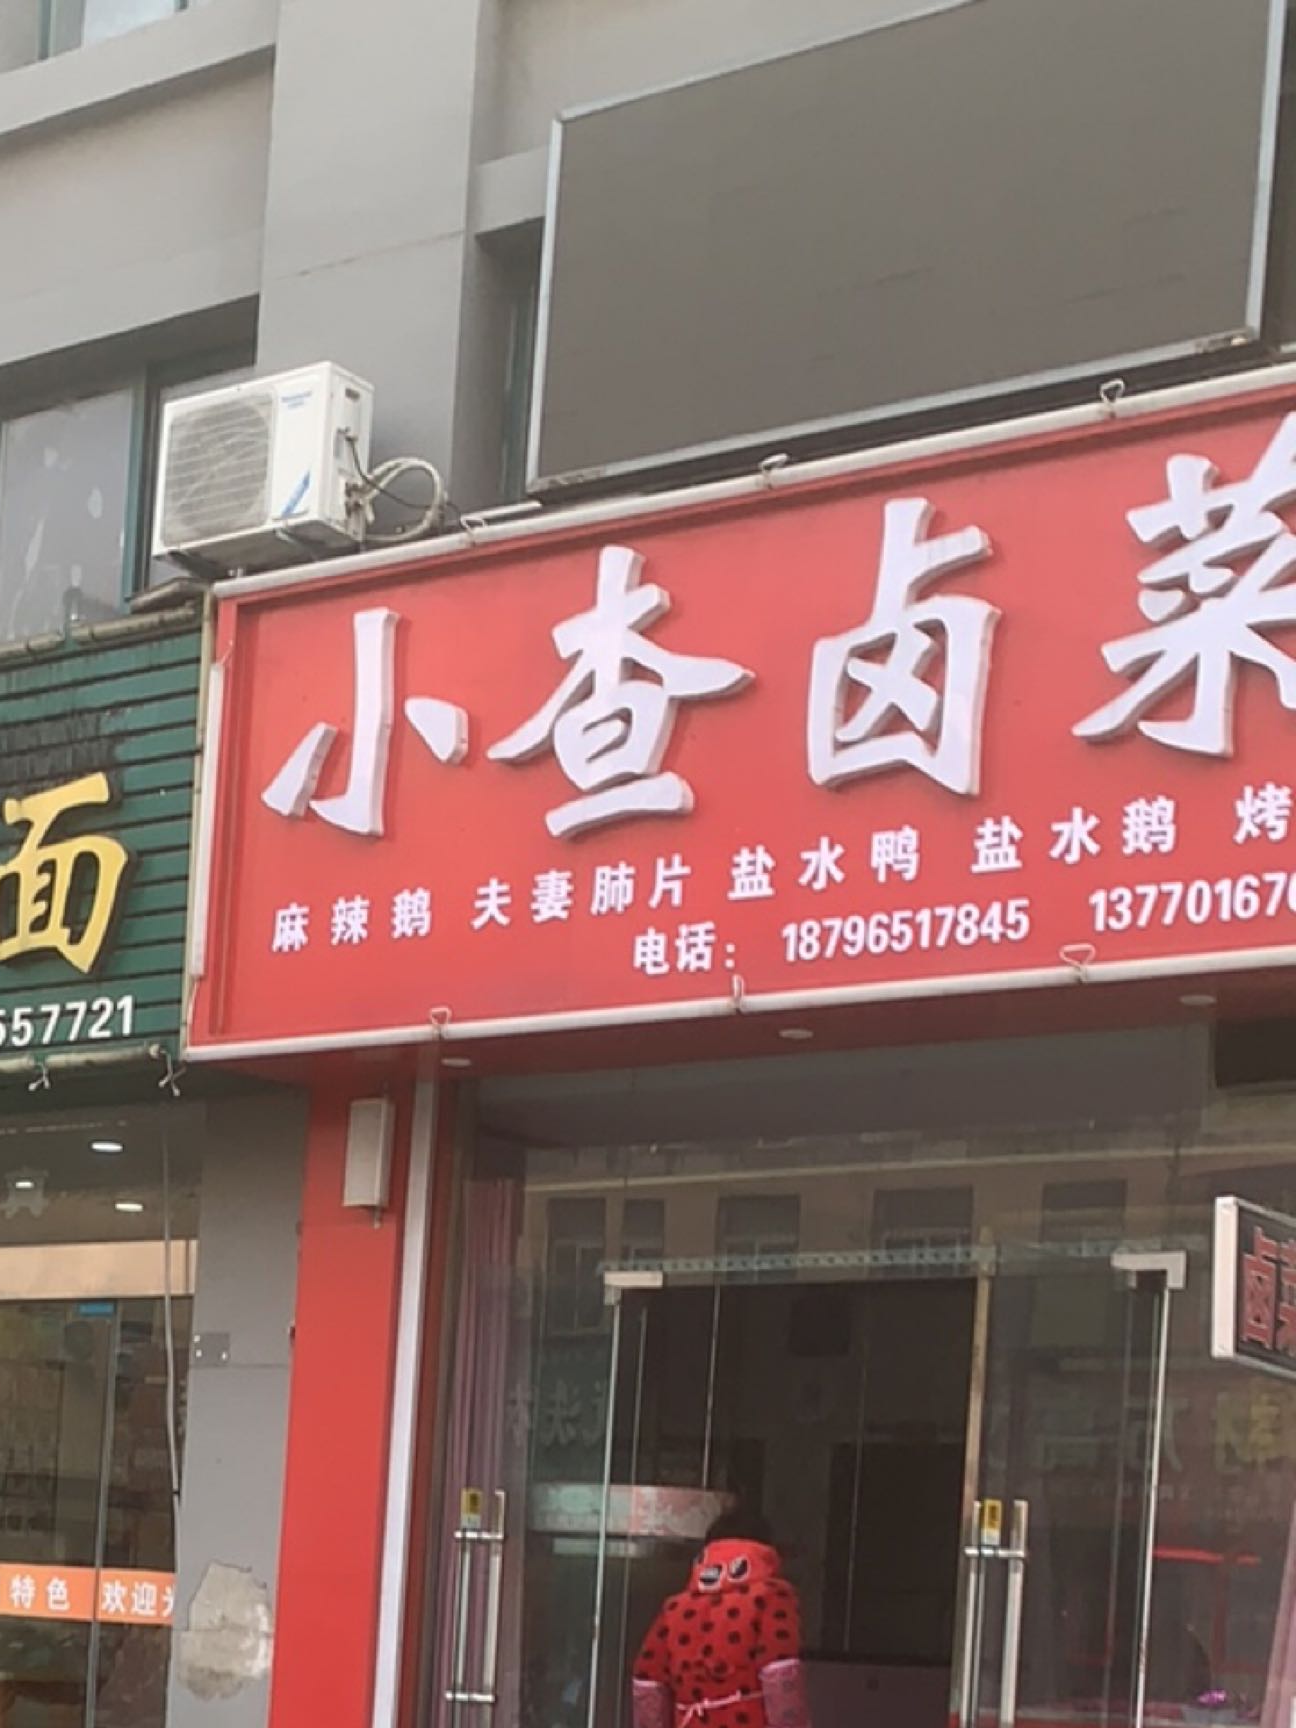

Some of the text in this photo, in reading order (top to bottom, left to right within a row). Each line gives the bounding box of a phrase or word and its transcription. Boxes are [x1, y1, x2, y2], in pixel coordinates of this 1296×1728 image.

[262, 410, 1296, 839] 小查卤菜
[271, 781, 1293, 954] 麻辣鹅 夫妻肺片 盐水鸭 盐水鹅 烤
[782, 898, 1030, 963] 18796517845
